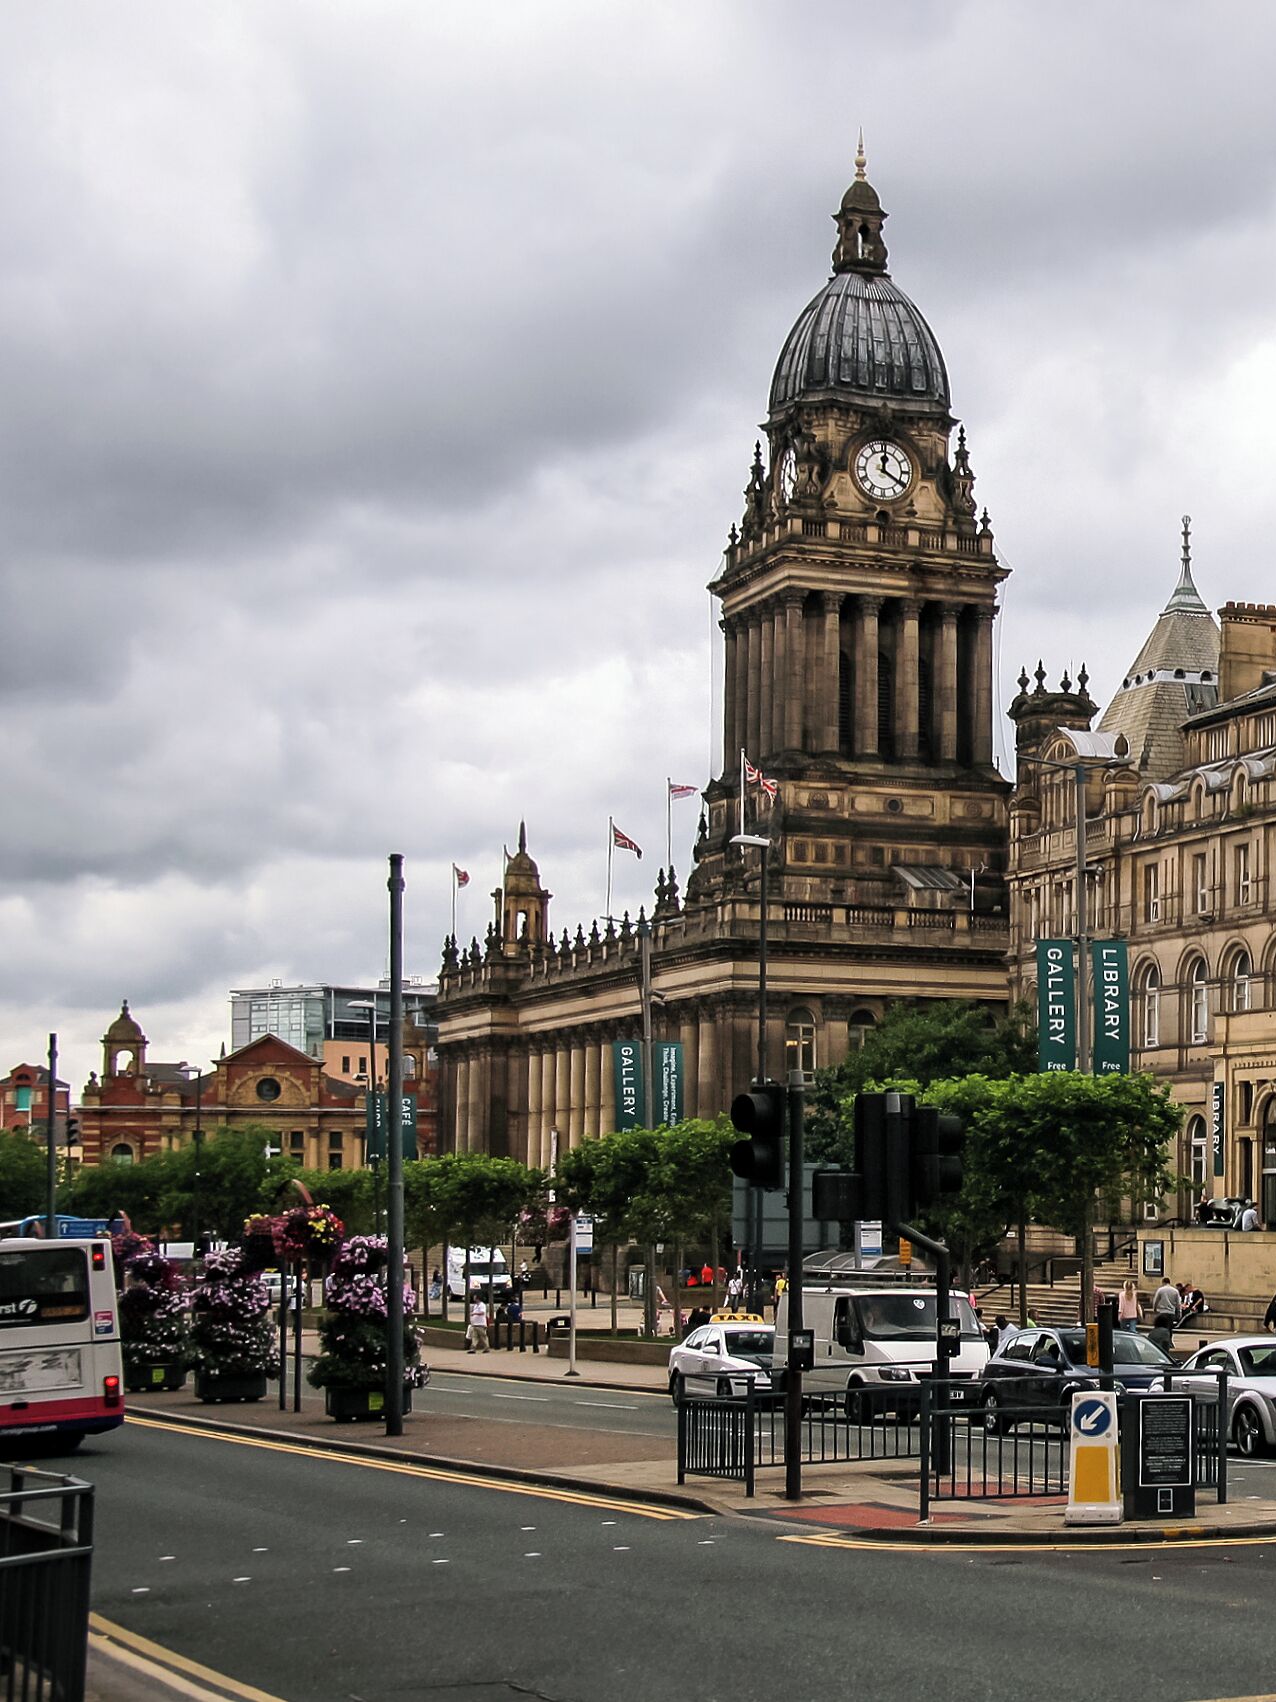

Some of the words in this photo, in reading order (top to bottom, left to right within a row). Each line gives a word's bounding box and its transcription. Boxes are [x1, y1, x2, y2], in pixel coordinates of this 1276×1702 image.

[1047, 948, 1065, 1044] GALLERY
[1102, 949, 1120, 1040] LIBRARY
[621, 1047, 636, 1116] GALLERY
[1047, 1061, 1066, 1070] Free
[1102, 1061, 1121, 1070] Free
[401, 1098, 413, 1126] CAFÉ
[1212, 1085, 1220, 1155] LIBRARY
[718, 1314, 759, 1322] TAXI
